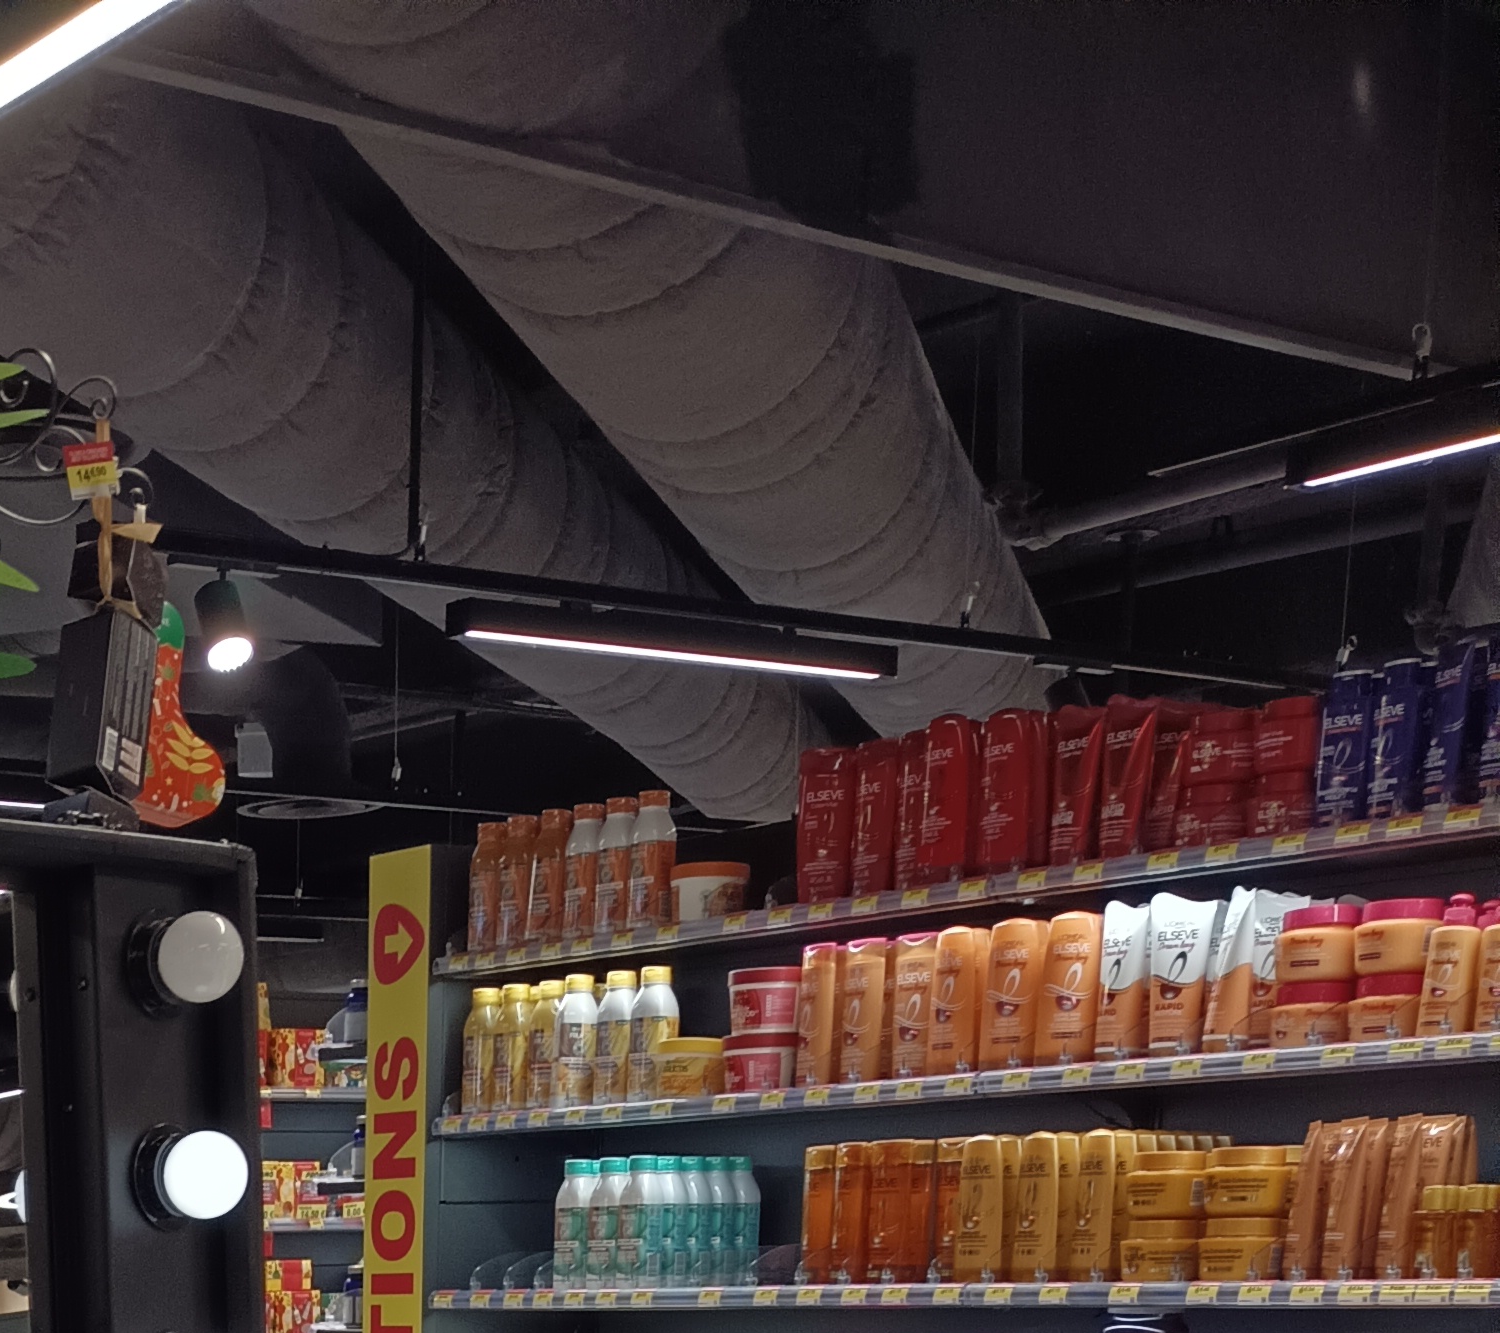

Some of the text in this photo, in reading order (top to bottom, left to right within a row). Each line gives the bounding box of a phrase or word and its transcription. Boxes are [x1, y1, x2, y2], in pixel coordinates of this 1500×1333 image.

[1324, 714, 1363, 730] ELSEVE
[806, 789, 845, 802] ELSEVE
[1156, 927, 1200, 942] ELSEVE
[993, 947, 1030, 961] ELSEVE
[1052, 941, 1092, 956] ELSEVE
[896, 969, 932, 985] ELSEVE
[1154, 1001, 1184, 1013] RAPID
